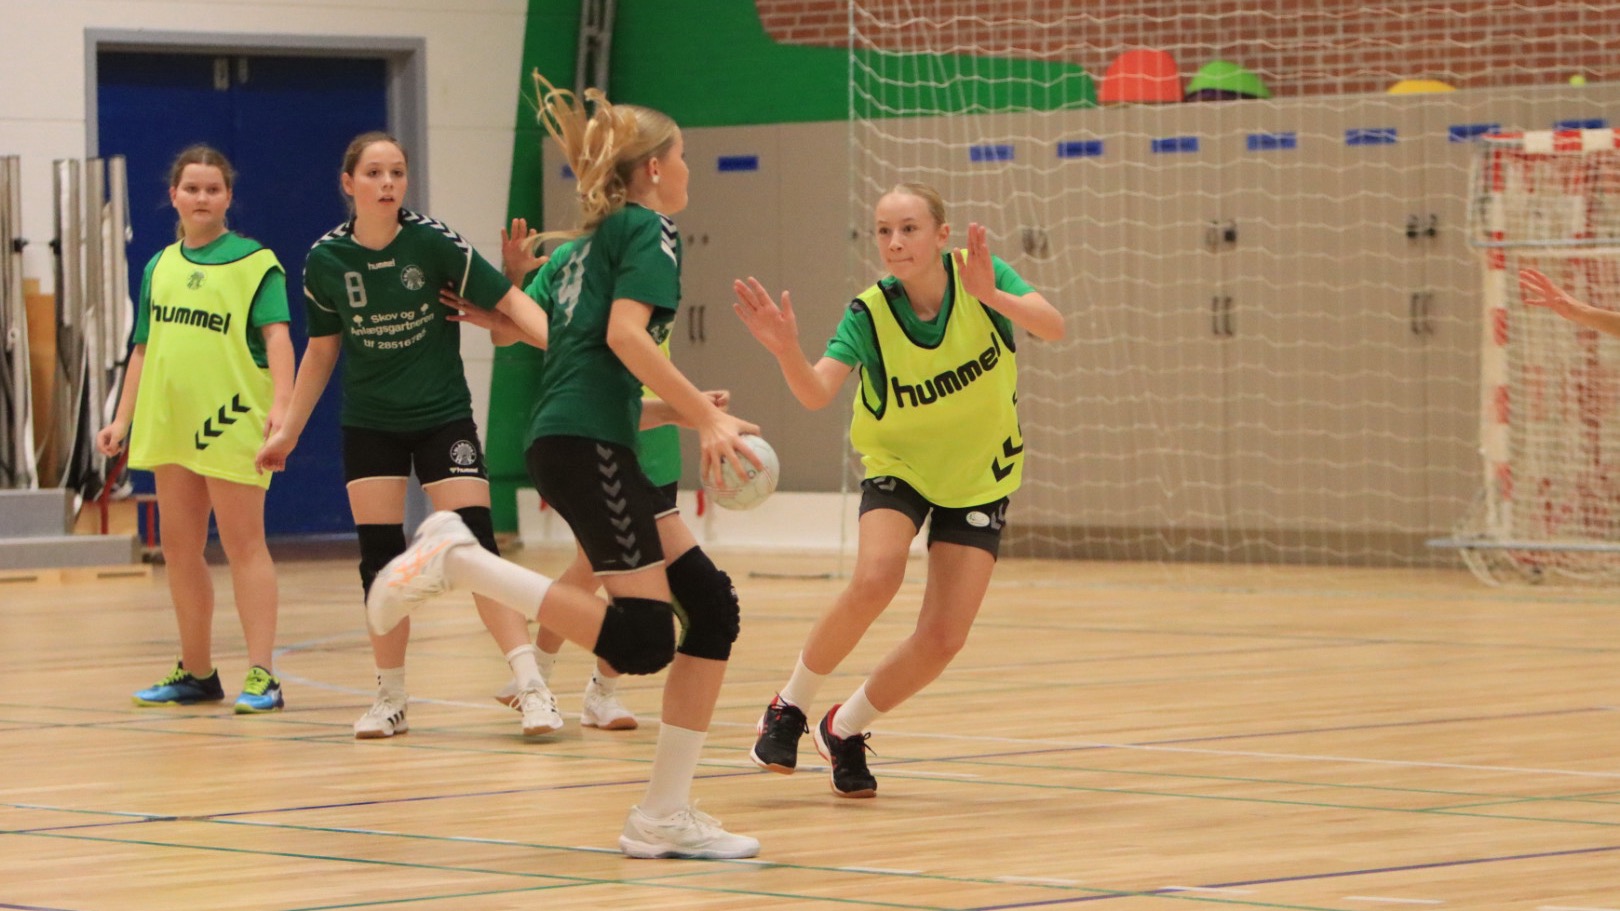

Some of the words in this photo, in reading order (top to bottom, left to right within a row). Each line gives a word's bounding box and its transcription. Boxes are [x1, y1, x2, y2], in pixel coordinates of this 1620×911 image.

[344, 271, 368, 308] 8
[152, 300, 231, 335] hummel
[370, 313, 398, 323] Skov
[400, 310, 415, 319] og
[891, 331, 1001, 409] hummel
